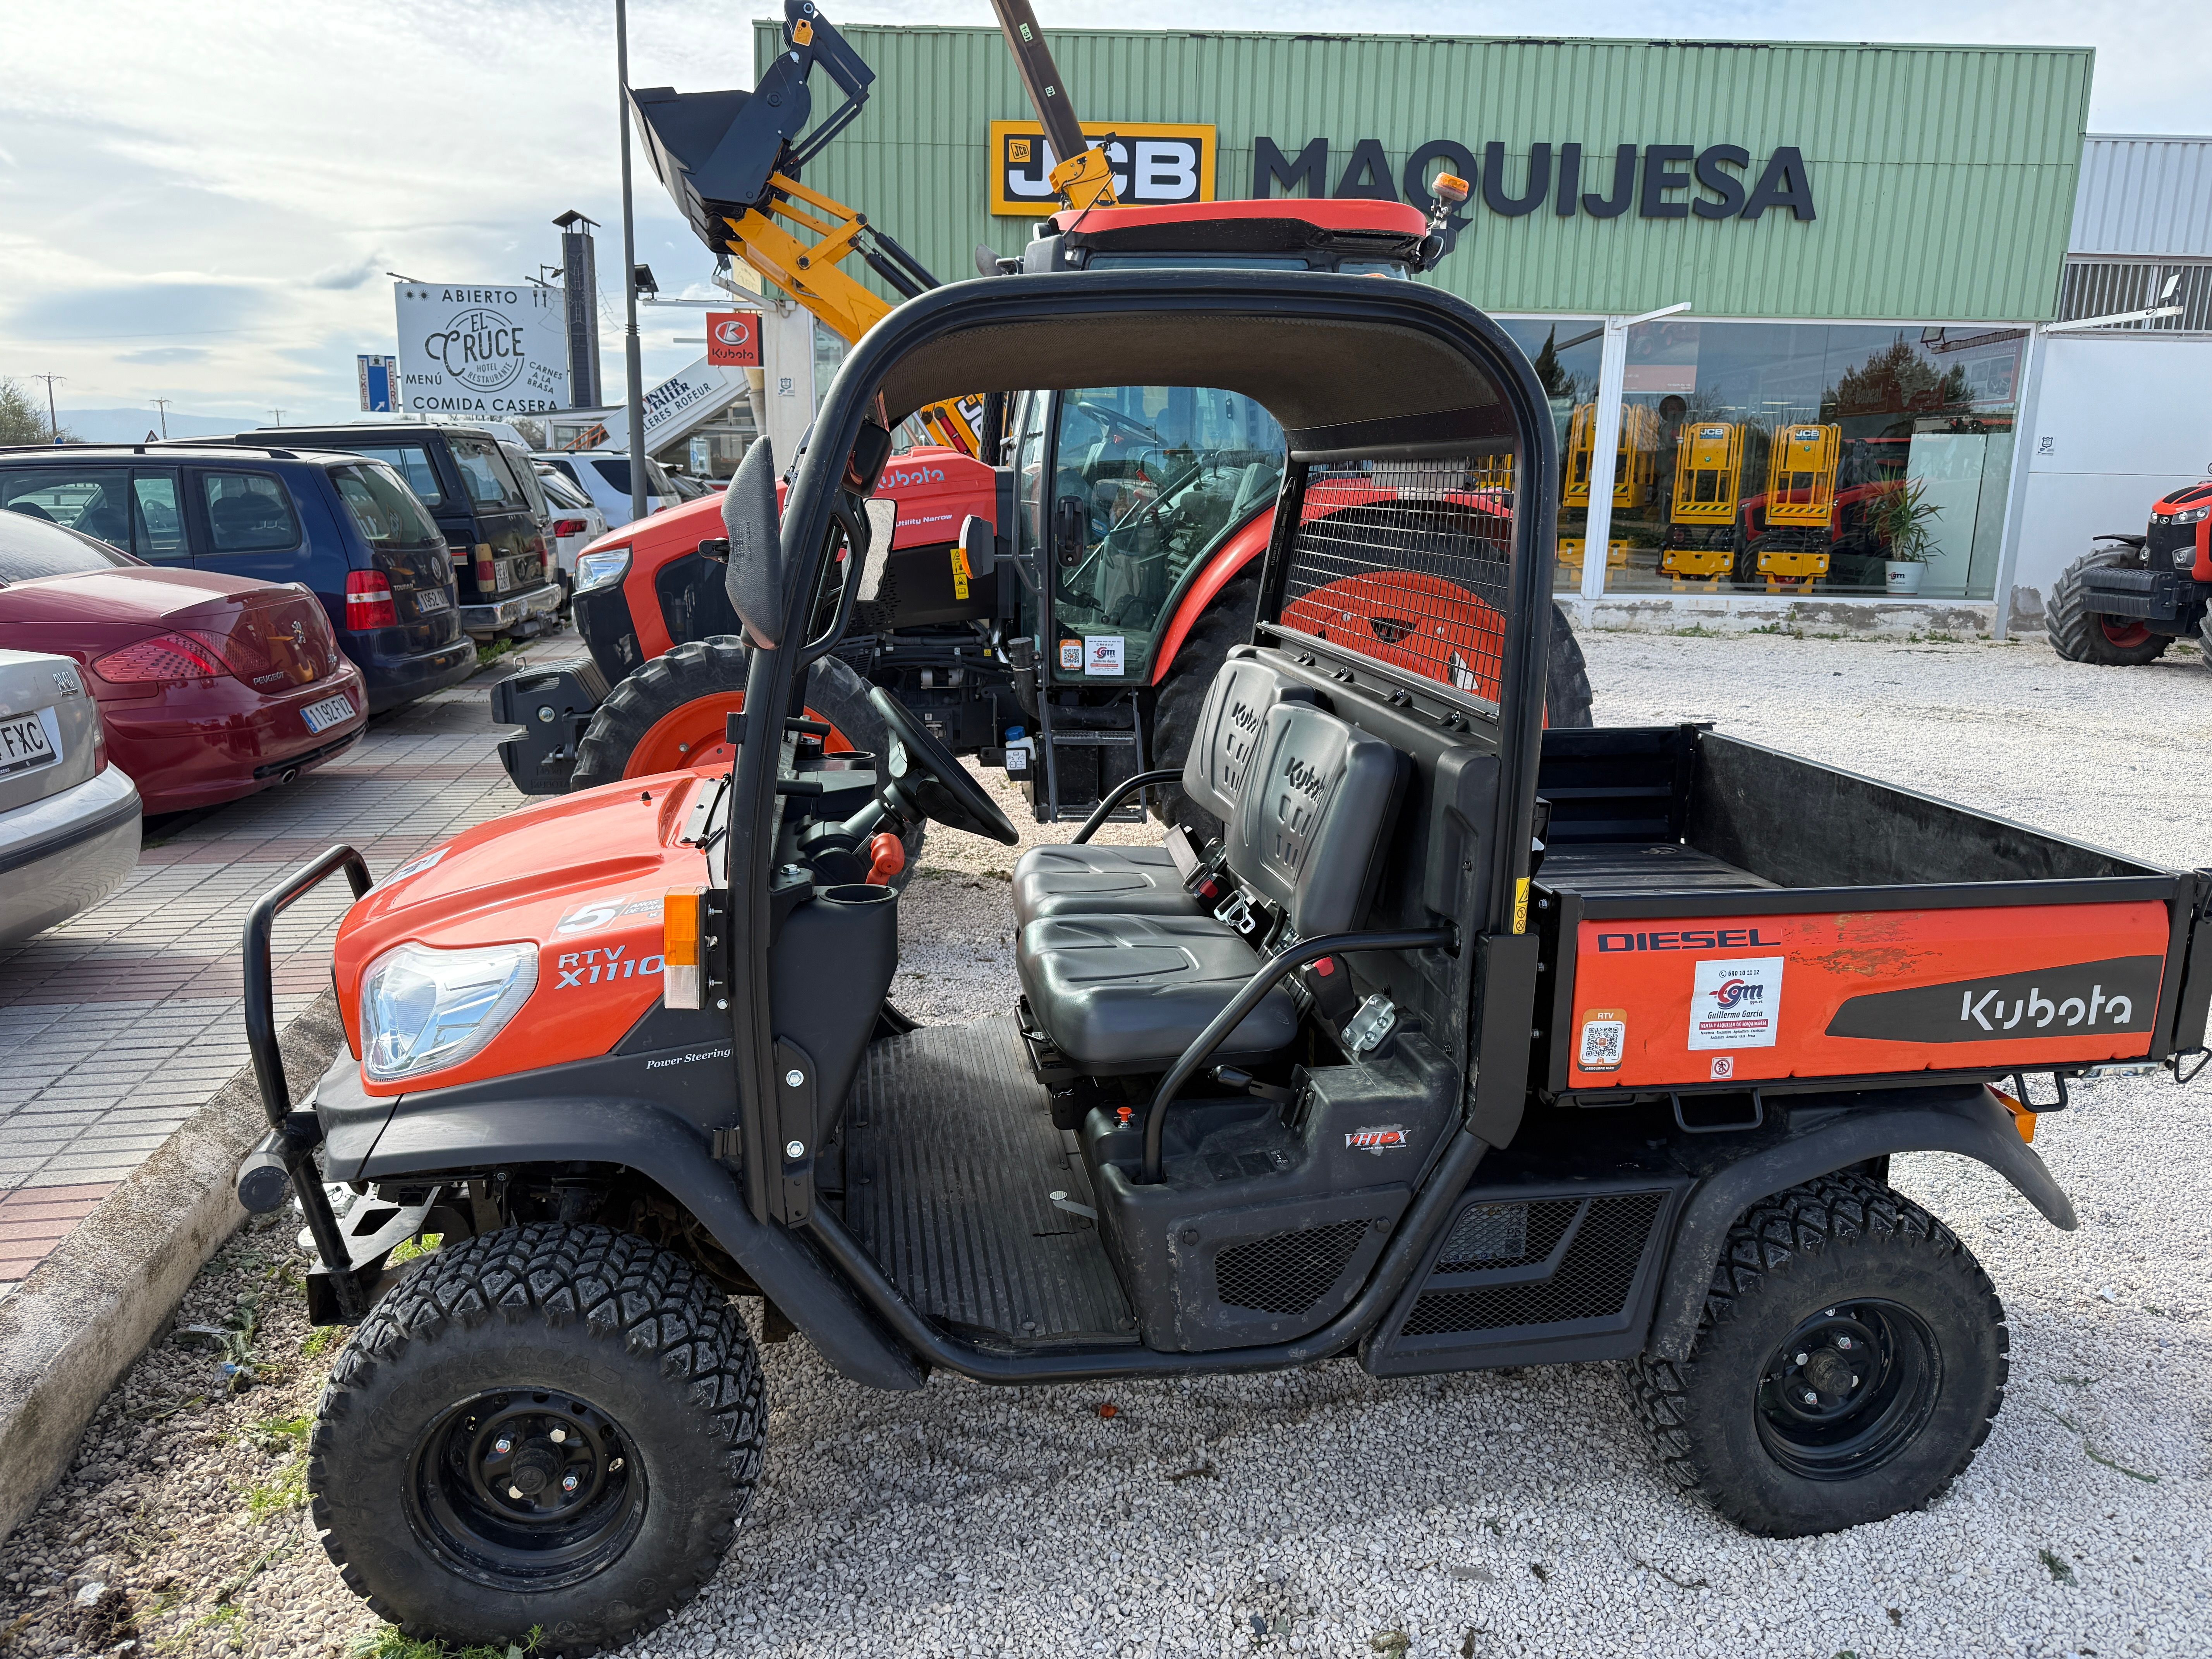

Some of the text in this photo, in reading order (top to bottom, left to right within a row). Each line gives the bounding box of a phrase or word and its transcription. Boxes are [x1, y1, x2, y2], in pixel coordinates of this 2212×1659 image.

[1014, 145, 1027, 156] JCB
[1253, 136, 1817, 232] MAQUIJESA
[441, 289, 517, 304] ABIERTO
[471, 312, 488, 332] EL
[425, 327, 525, 376] CRUCE
[712, 348, 754, 360] Kubota
[467, 361, 513, 383] RESTAURANTE
[477, 362, 498, 372] HOTEL
[529, 361, 563, 381] CARNES
[360, 360, 369, 410] TICKETS
[388, 361, 396, 410] FERRY
[406, 372, 442, 385] MENÚ
[527, 380, 554, 395] BRASA
[541, 374, 551, 385] LA
[646, 378, 680, 404] INTER
[650, 382, 690, 410] TALLER
[674, 383, 712, 410] ROFEUR
[413, 397, 485, 410] COMIDA
[492, 399, 558, 412] CASERA
[896, 514, 953, 527] Utility Narrow
[421, 591, 439, 609] 1952
[253, 671, 285, 685] PEUGEOT
[309, 697, 353, 727] 1192 FVZ
[0, 721, 43, 757] FXC
[558, 898, 659, 933] 5 AÑOS
[1597, 928, 1781, 952] DIESEL
[558, 945, 626, 969] RTV
[554, 954, 665, 990] X1110
[1708, 1009, 1763, 1019] Guillermo García
[1961, 984, 2132, 1031] Kubota
[646, 1048, 731, 1070] Power Steering
[1345, 1130, 1412, 1150] VHT-X
